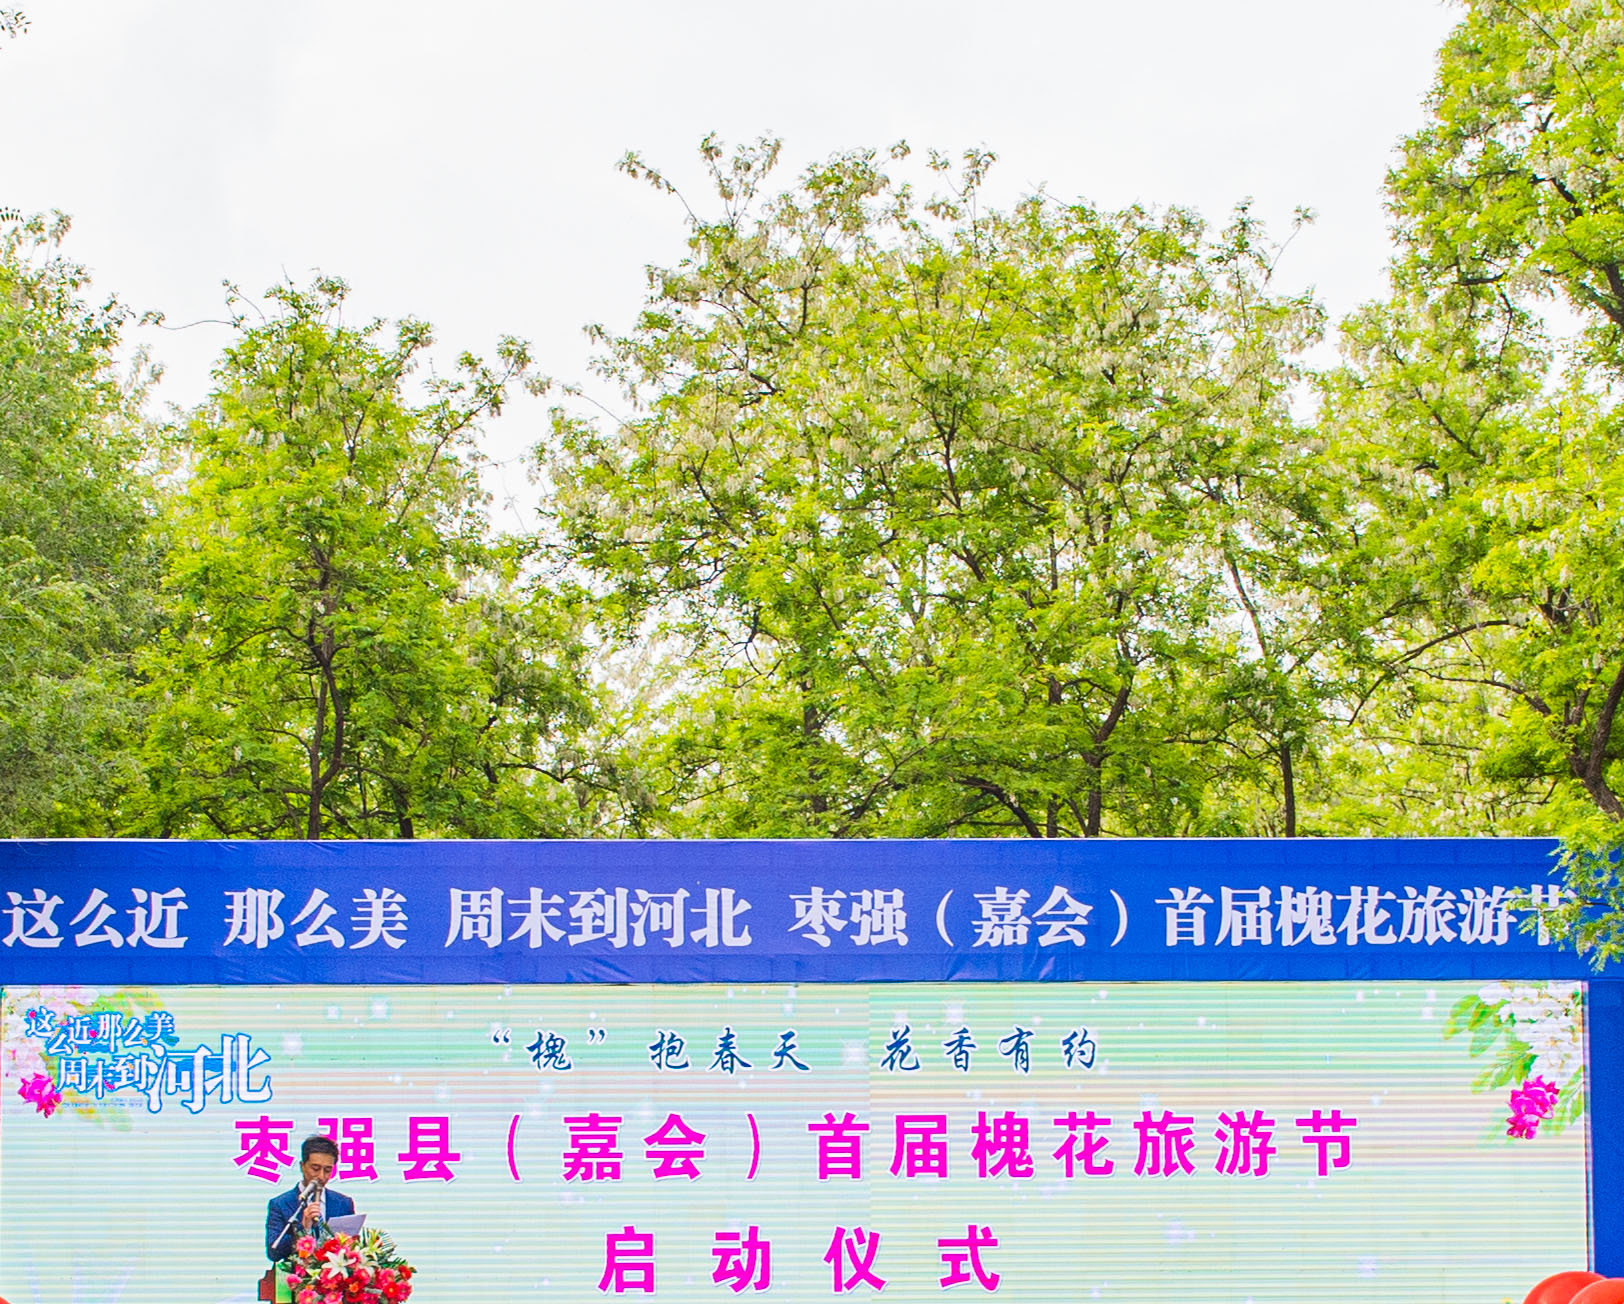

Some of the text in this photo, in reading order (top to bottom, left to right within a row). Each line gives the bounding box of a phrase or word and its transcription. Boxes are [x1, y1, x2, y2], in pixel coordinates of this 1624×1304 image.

[1, 886, 189, 949] 这么近
[222, 886, 409, 950] 那么美
[443, 885, 753, 950] 周末到河北
[879, 1024, 1097, 1073] 花香有约
[232, 1108, 1359, 1185] 枣强县（嘉会）首届槐花旅游节
[598, 1223, 1001, 1294] 启动仪式
